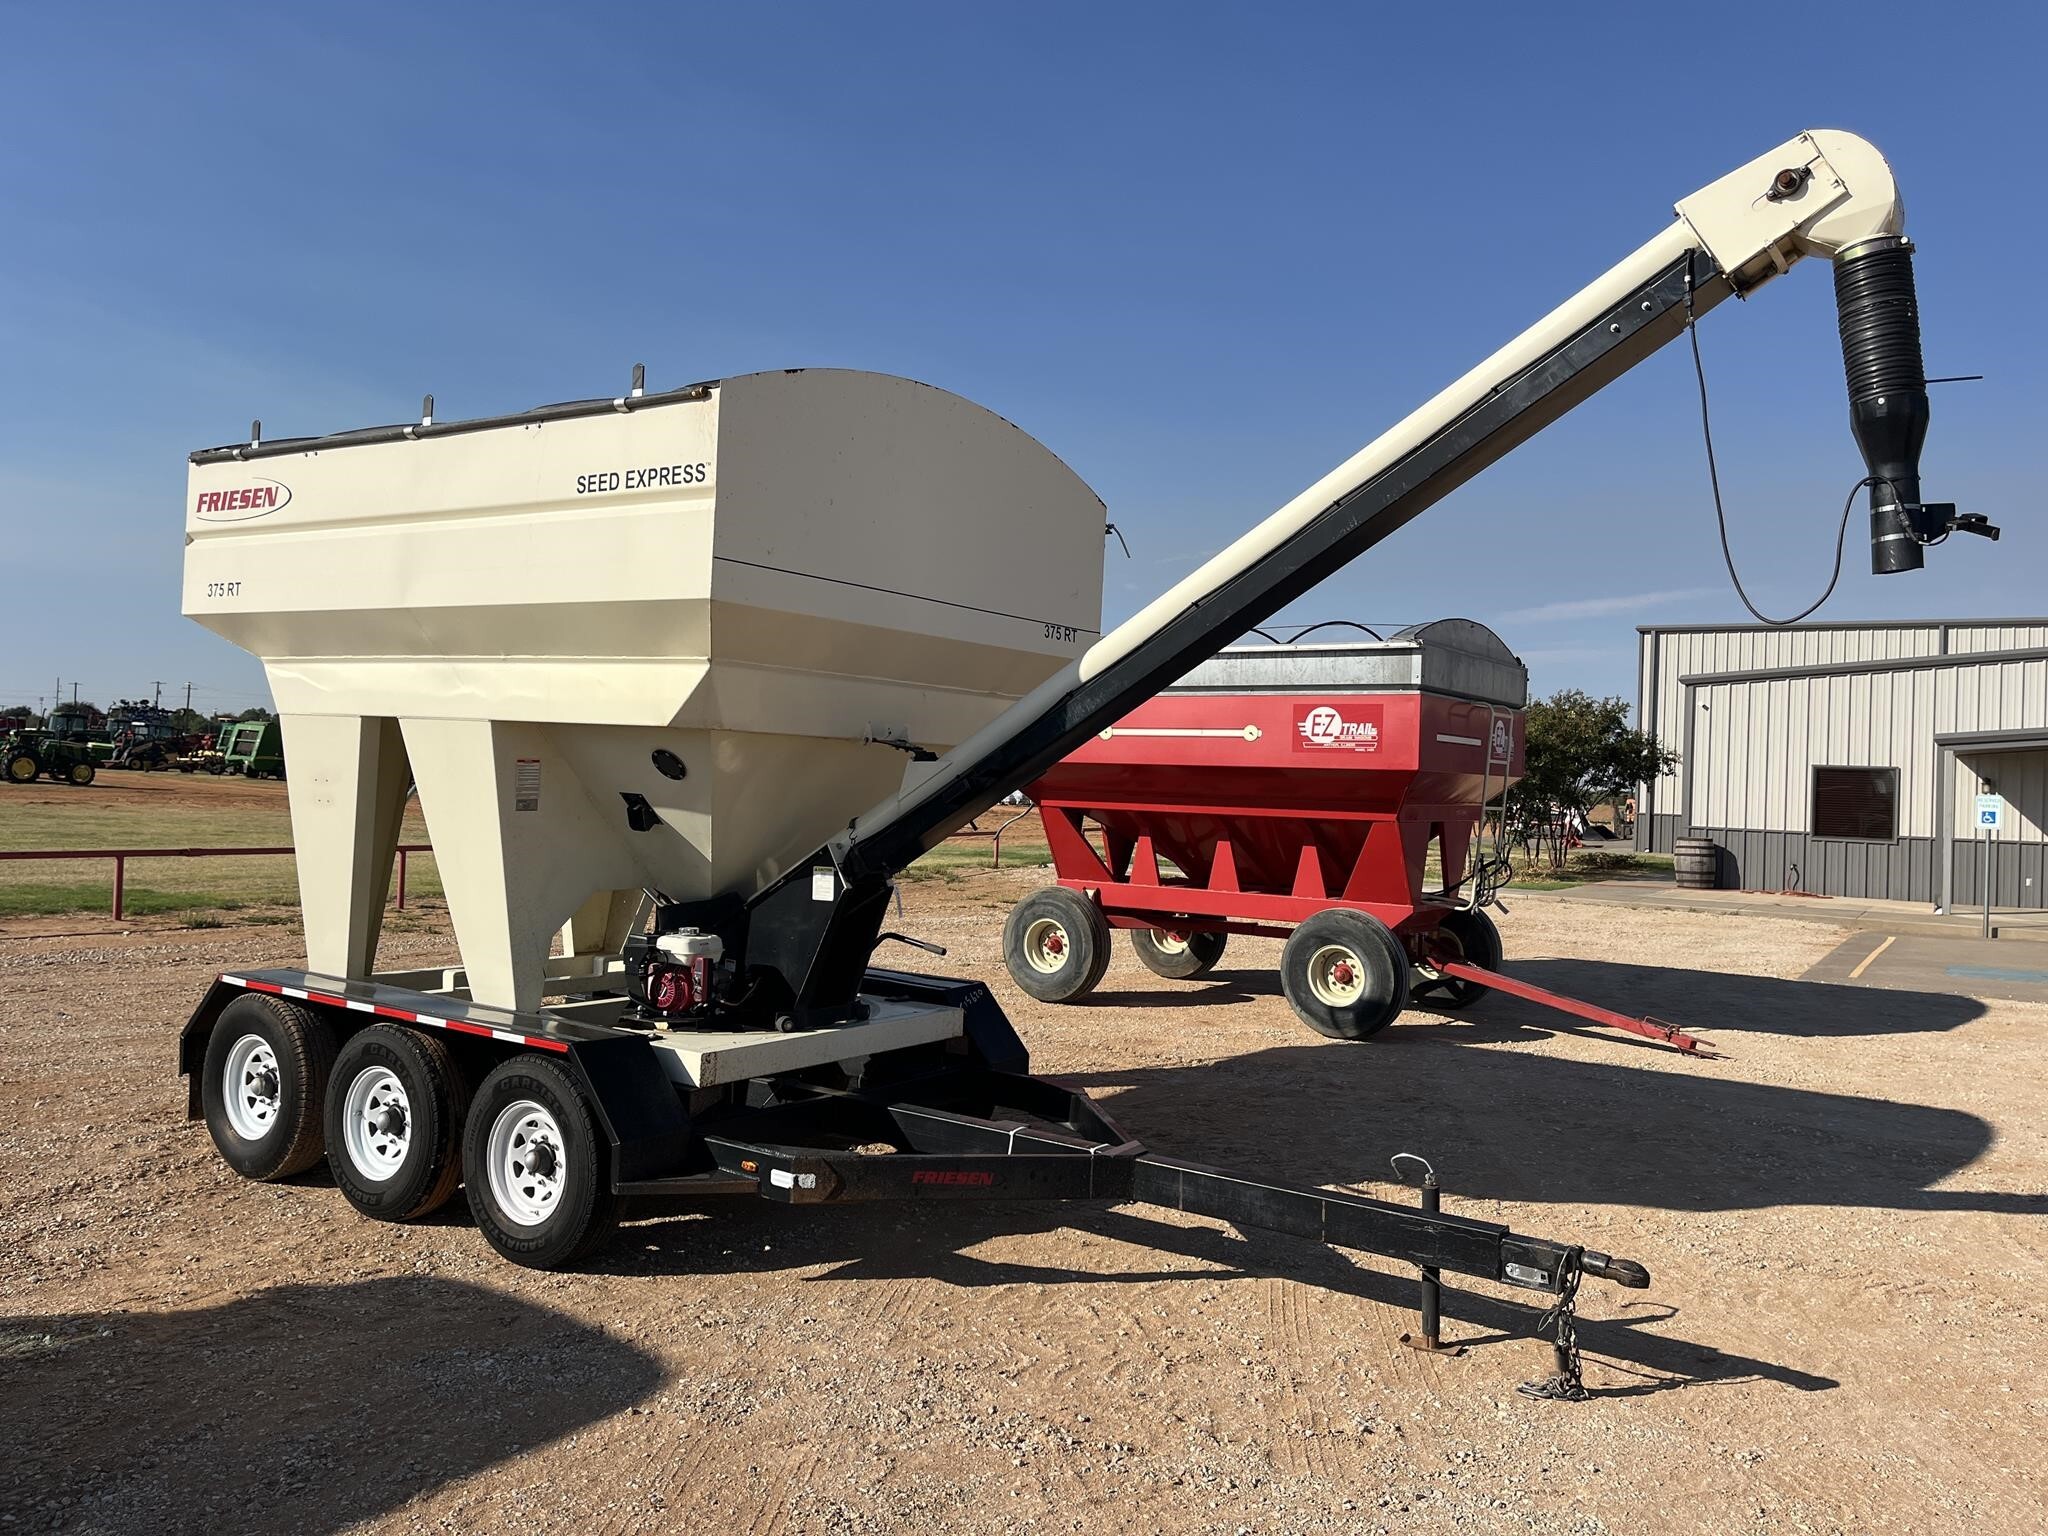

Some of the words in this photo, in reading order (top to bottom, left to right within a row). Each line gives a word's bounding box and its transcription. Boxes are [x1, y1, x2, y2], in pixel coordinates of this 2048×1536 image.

[576, 472, 620, 494] SEED
[196, 486, 279, 513] FRIESEN
[207, 583, 225, 597] 375
[227, 582, 241, 597] RT
[1044, 624, 1061, 640] 375
[1064, 627, 1077, 643] RT
[1341, 722, 1373, 735] TRAIL
[912, 1171, 993, 1185] FRIESEN
